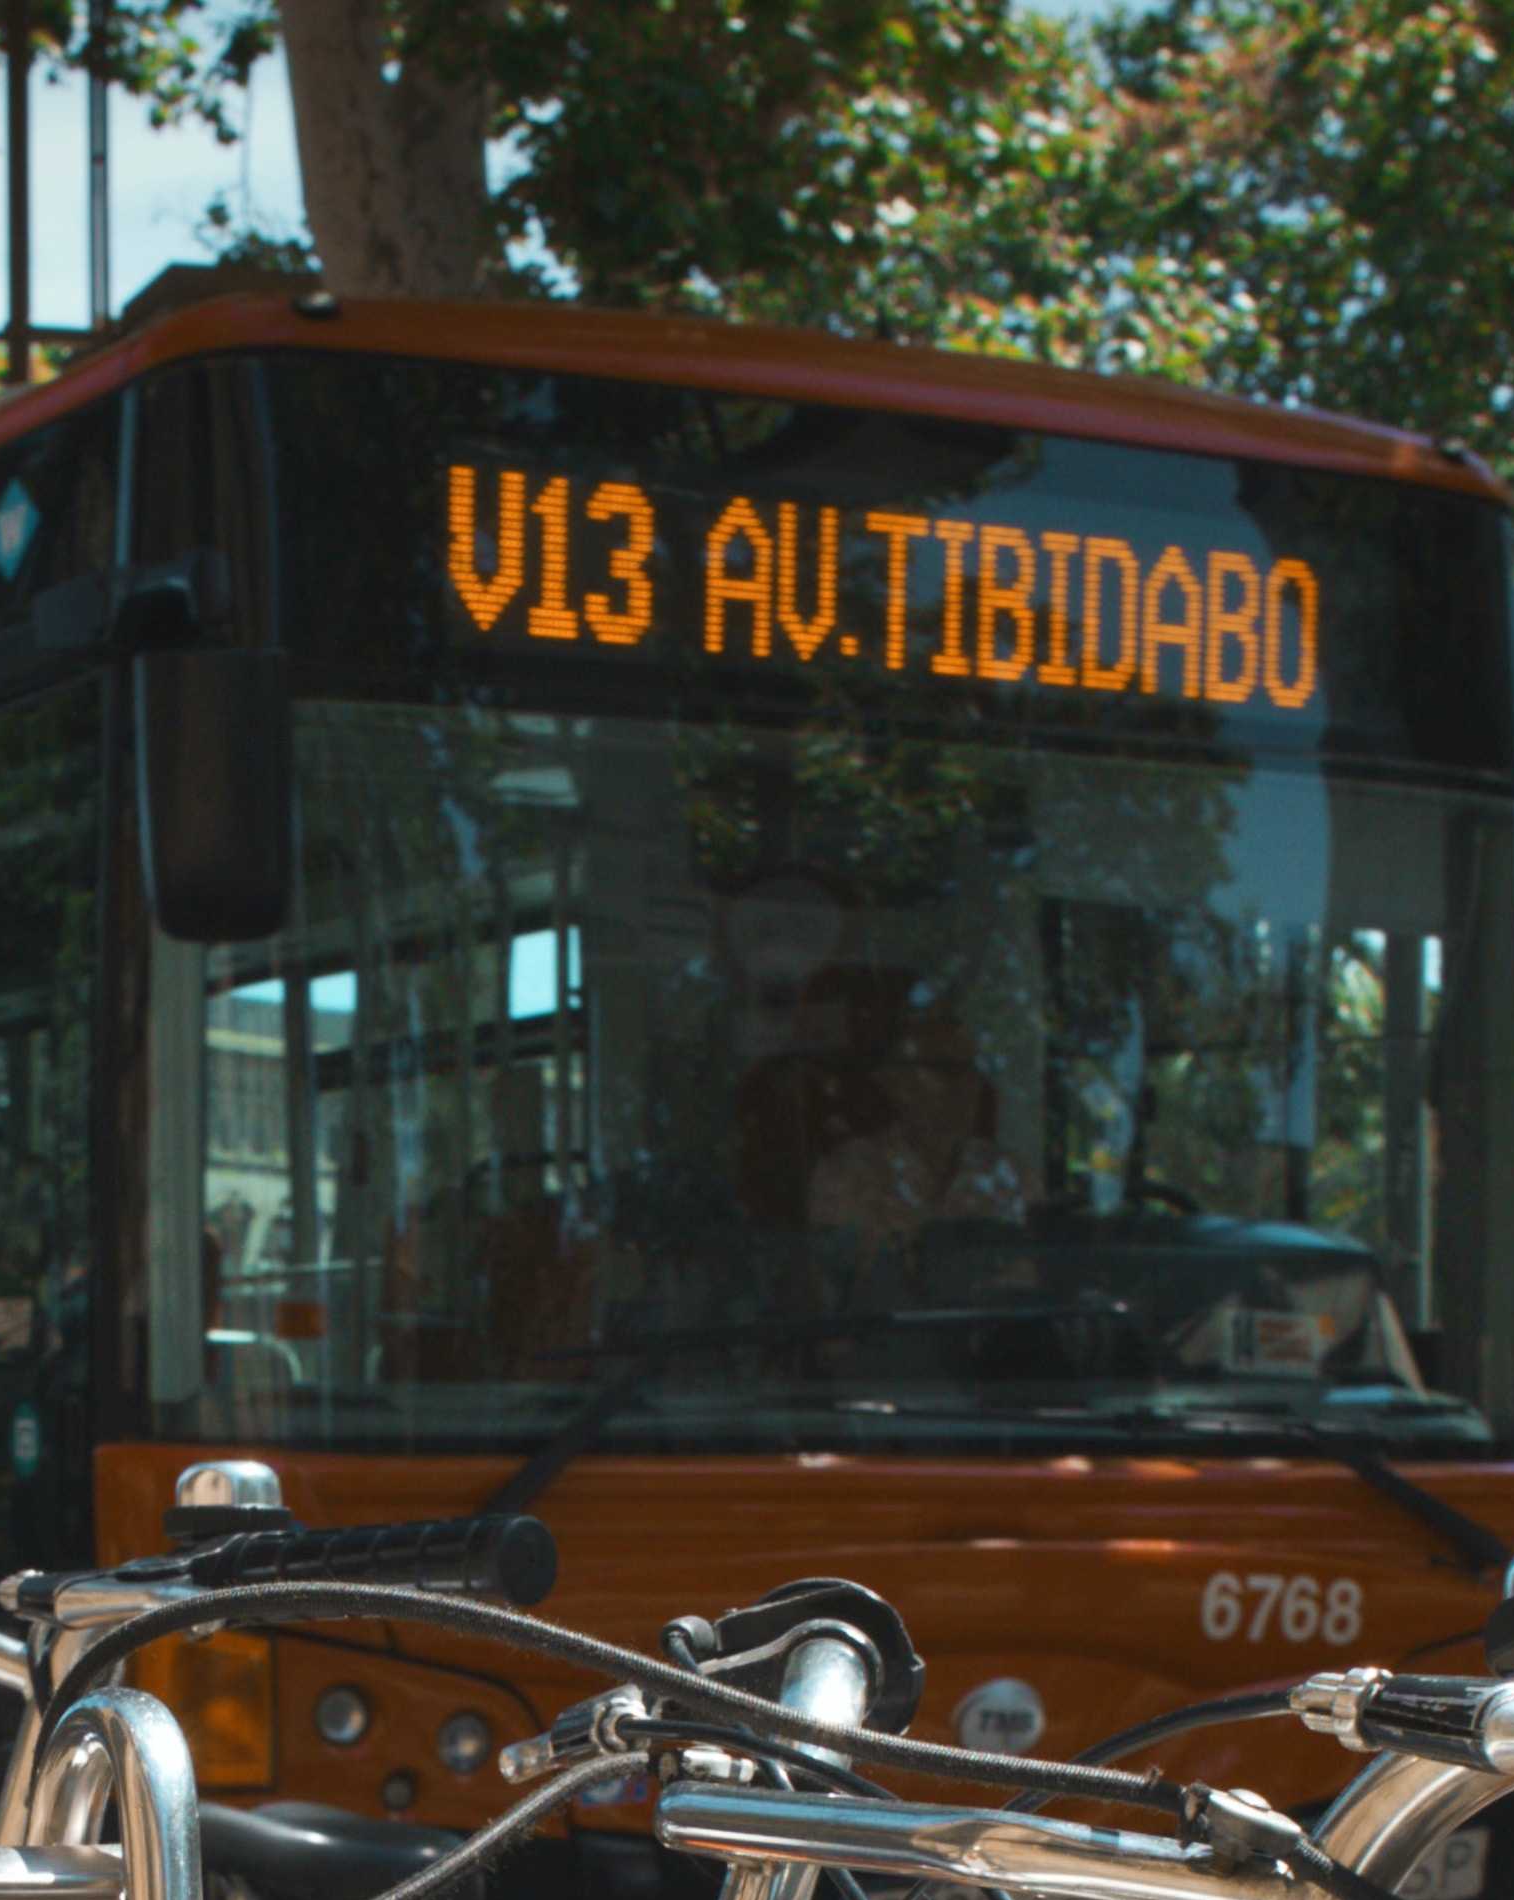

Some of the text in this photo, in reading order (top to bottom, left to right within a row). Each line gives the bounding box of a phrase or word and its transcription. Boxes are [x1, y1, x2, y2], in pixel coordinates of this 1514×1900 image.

[448, 465, 1319, 708] V13 AV.TIBIDABO
[1201, 1571, 1363, 1644] 6768
